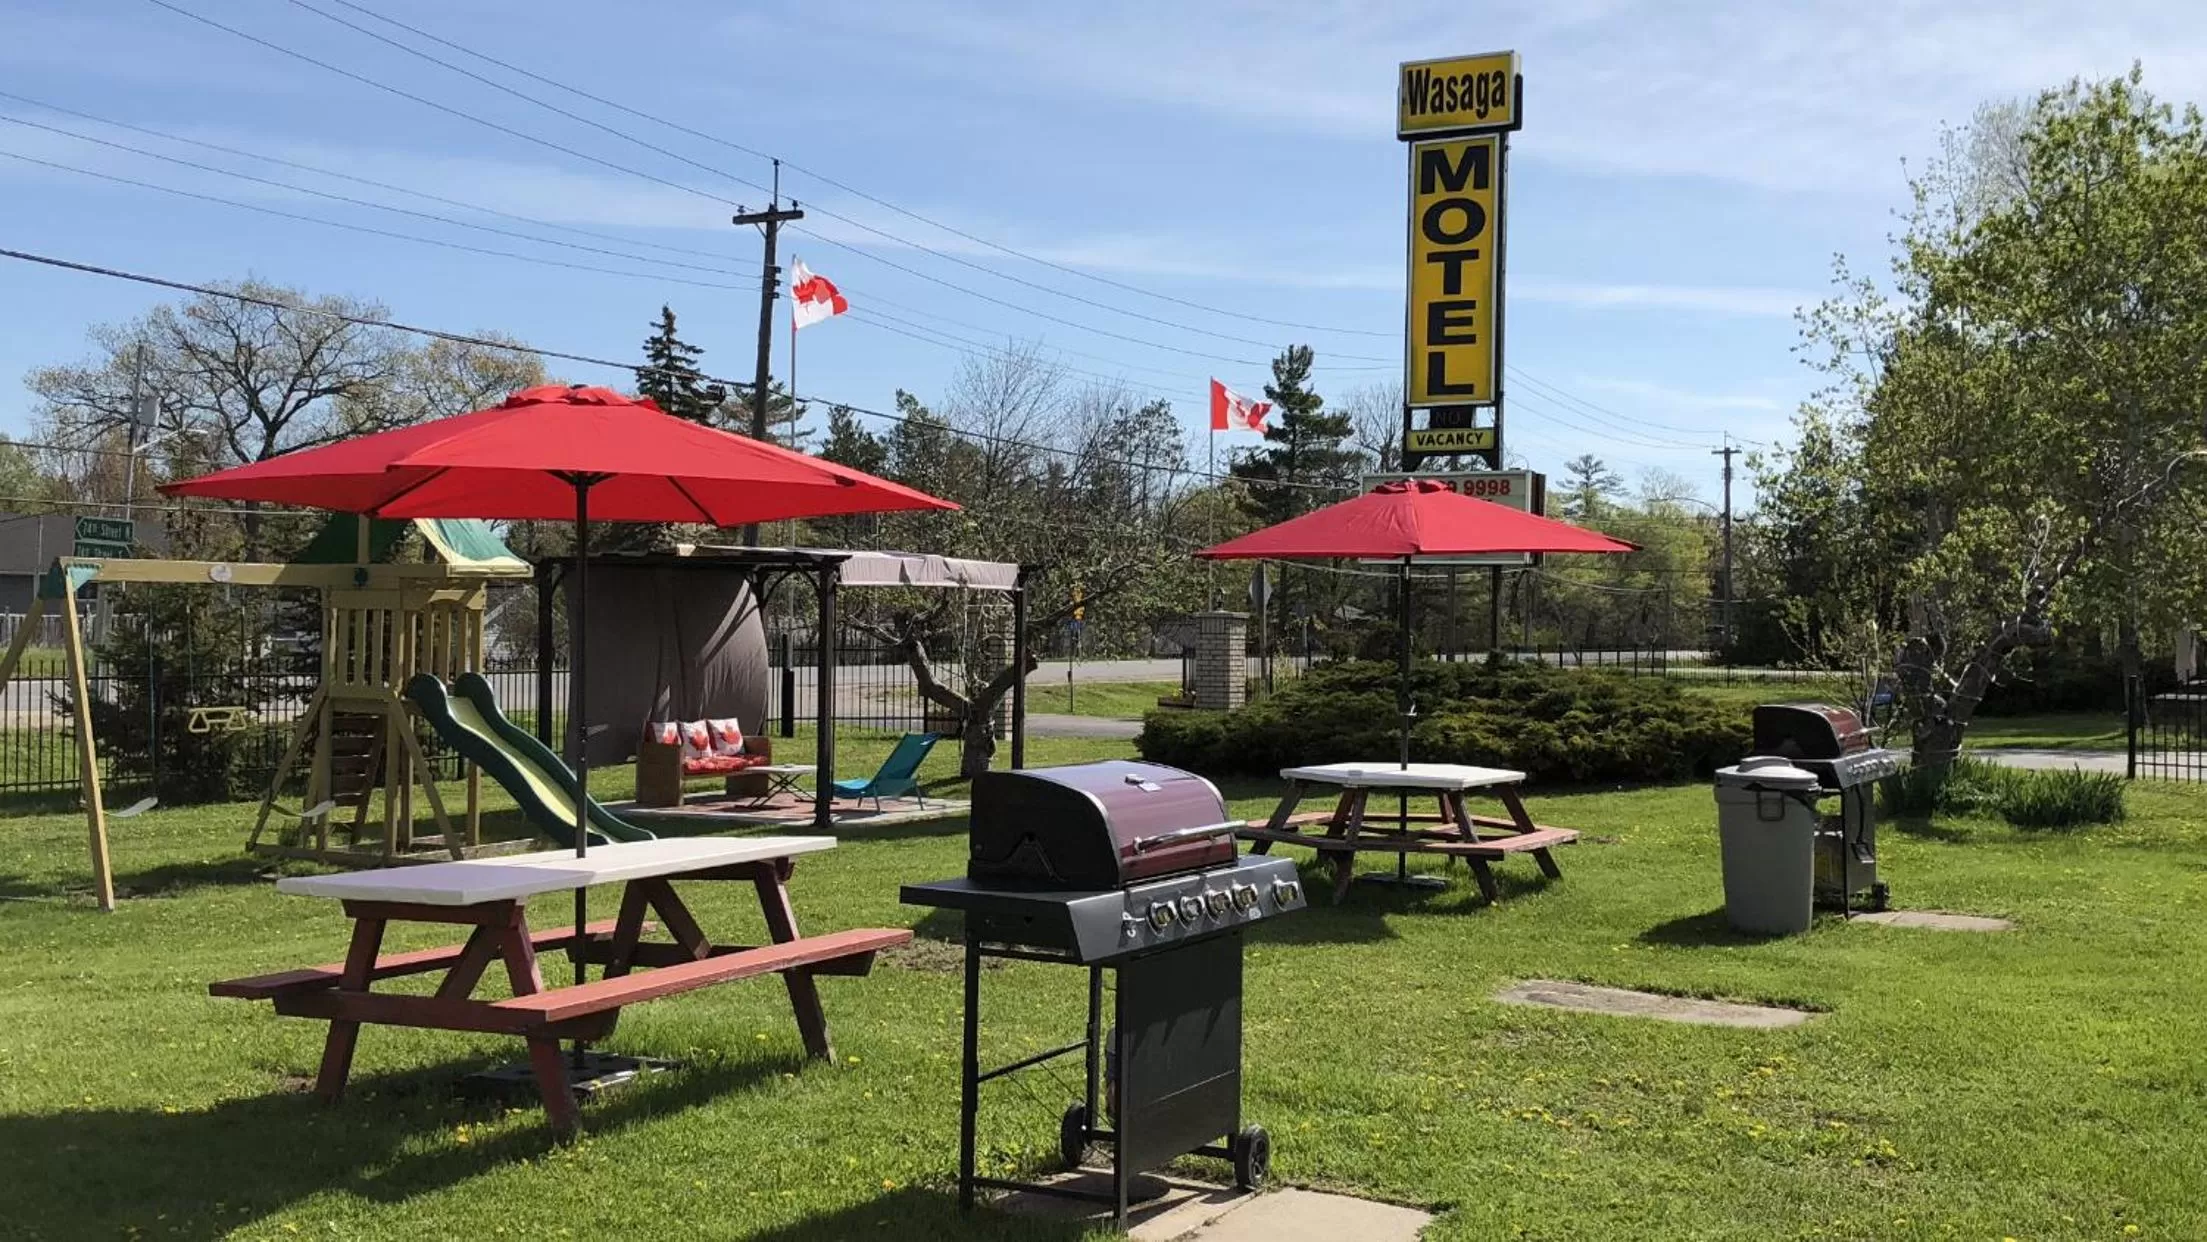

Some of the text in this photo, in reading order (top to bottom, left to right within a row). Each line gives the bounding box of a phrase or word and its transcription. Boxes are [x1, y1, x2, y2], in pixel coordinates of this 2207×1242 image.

[1406, 67, 1506, 119] Wasaga
[1420, 145, 1490, 396] MOTEL
[1435, 411, 1461, 426] NO
[1416, 431, 1485, 447] VACANCY
[1463, 479, 1511, 496] 9998
